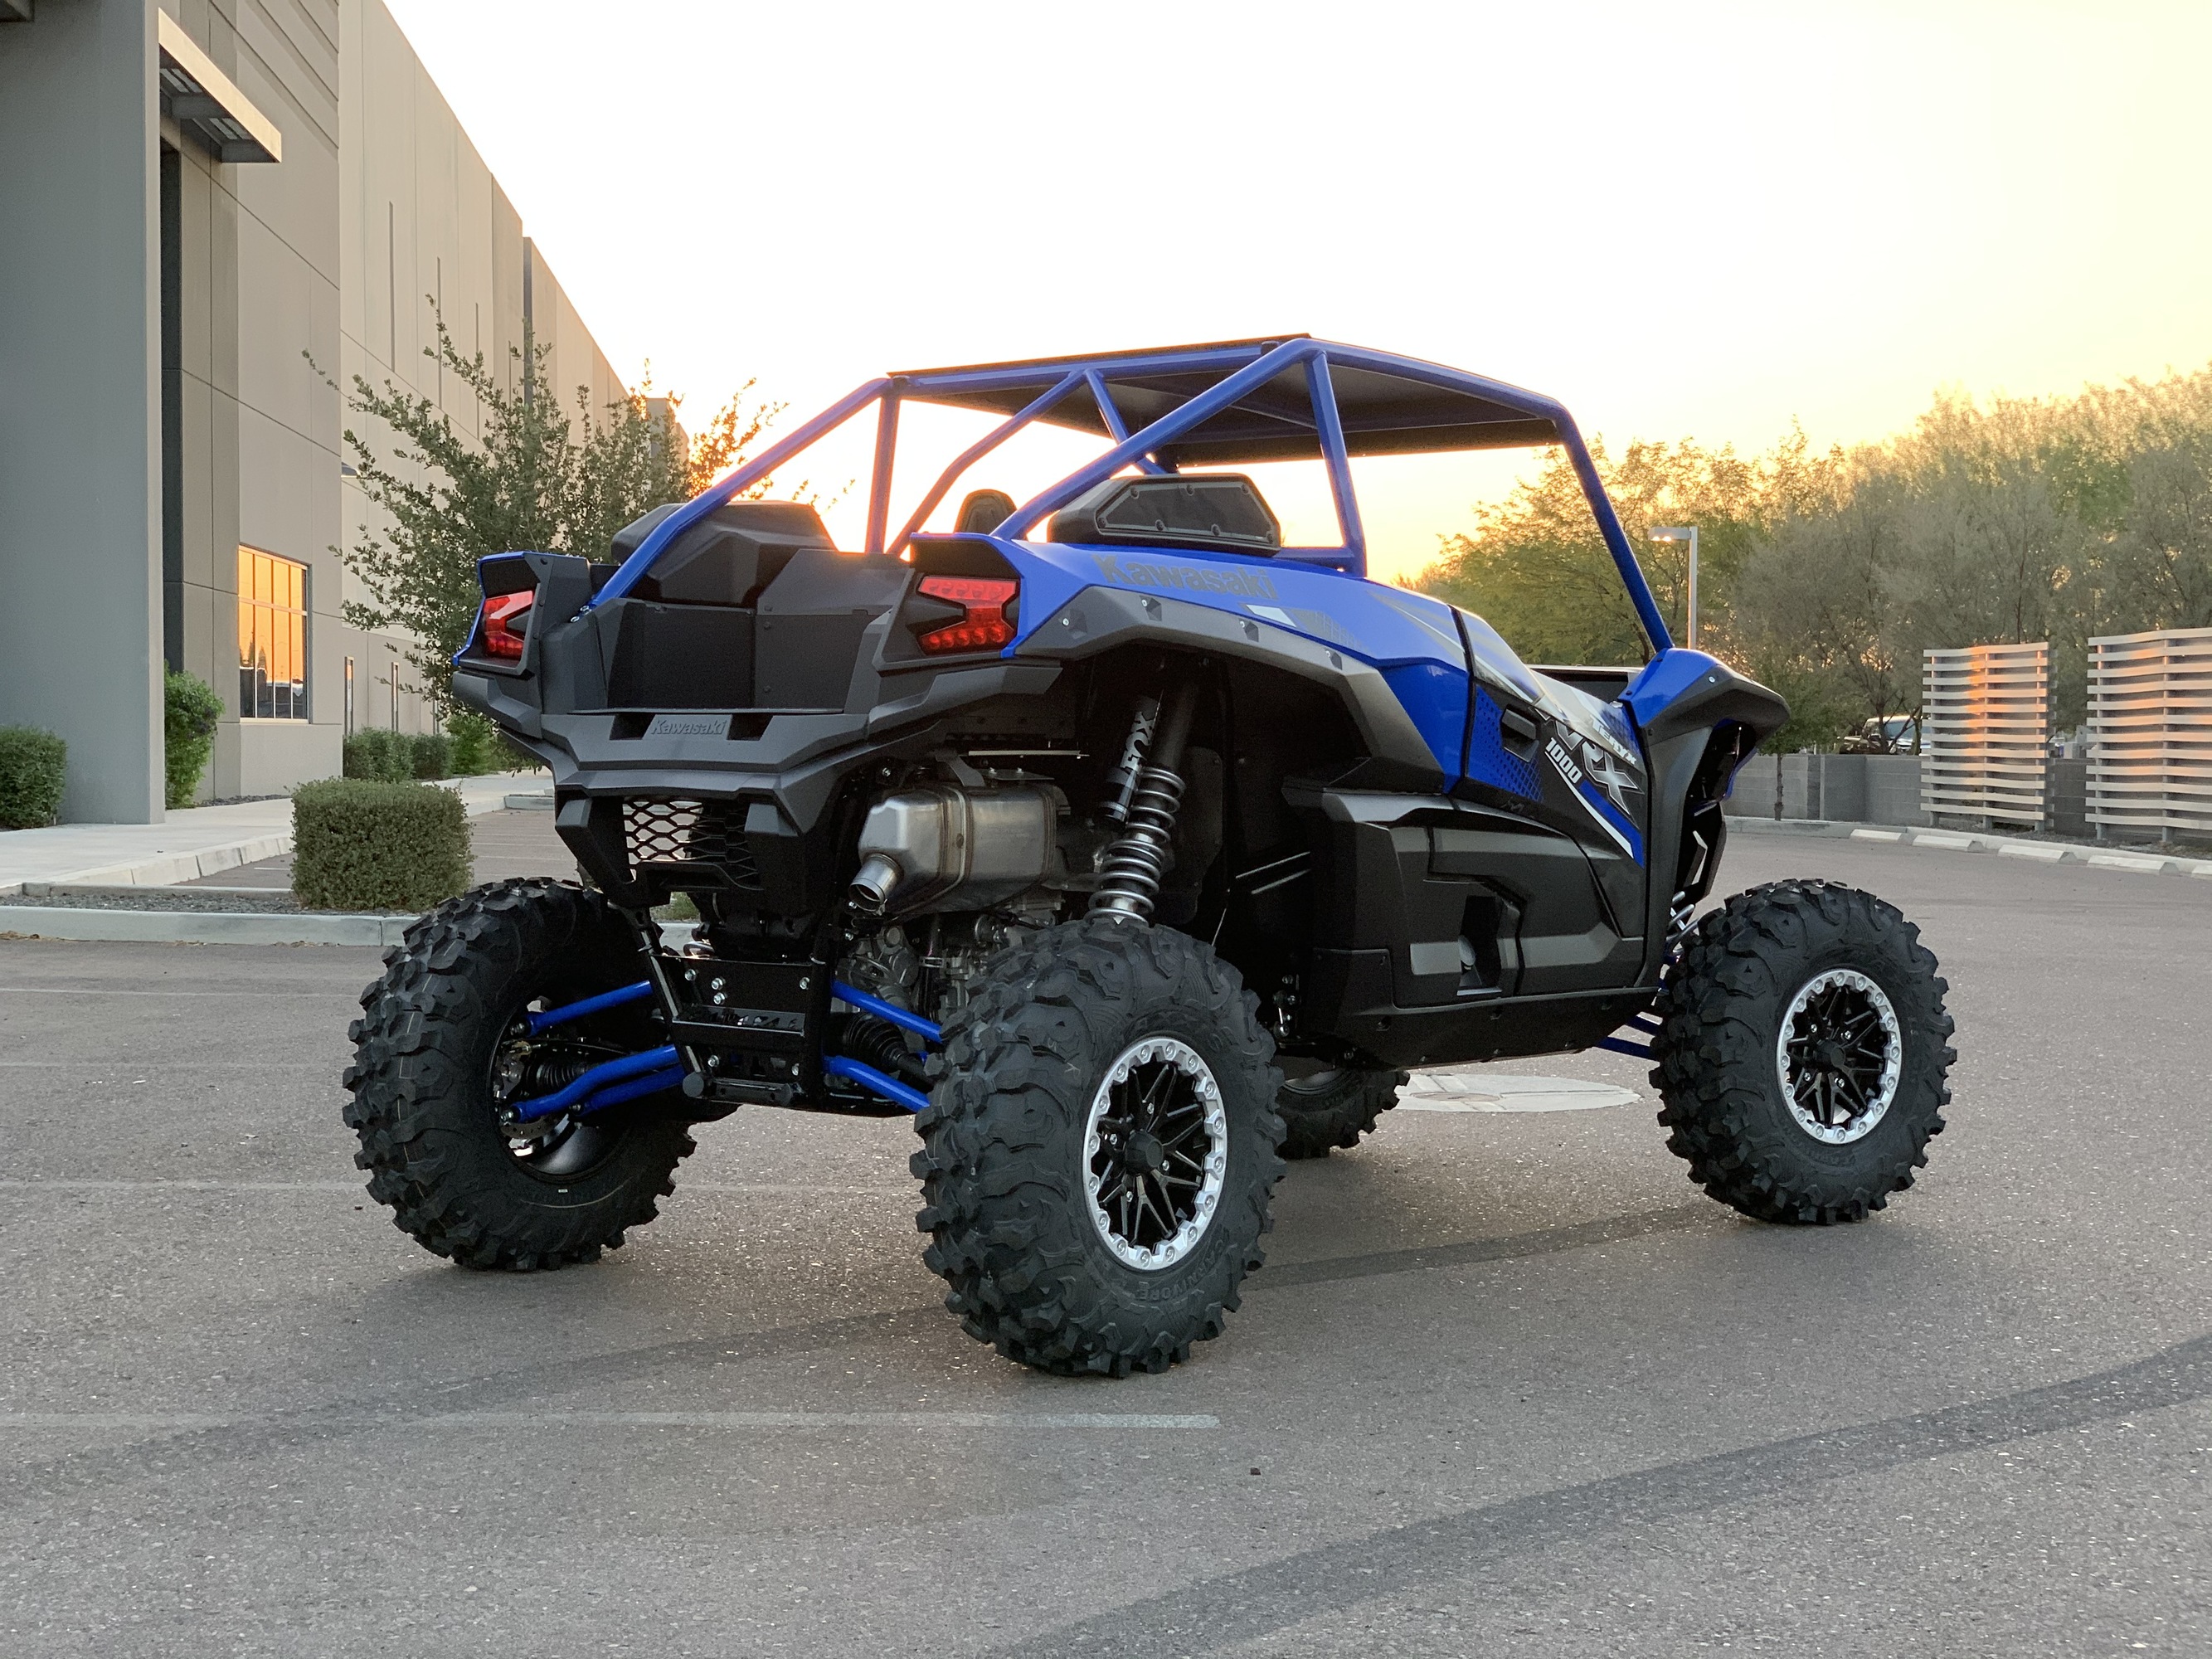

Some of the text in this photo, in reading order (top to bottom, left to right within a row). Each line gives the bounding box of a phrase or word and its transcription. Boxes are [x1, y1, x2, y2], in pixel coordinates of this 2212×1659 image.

[1091, 553, 1279, 601] Kawasaki
[650, 718, 727, 735] Kawasaki
[1545, 737, 1582, 784] 1000
